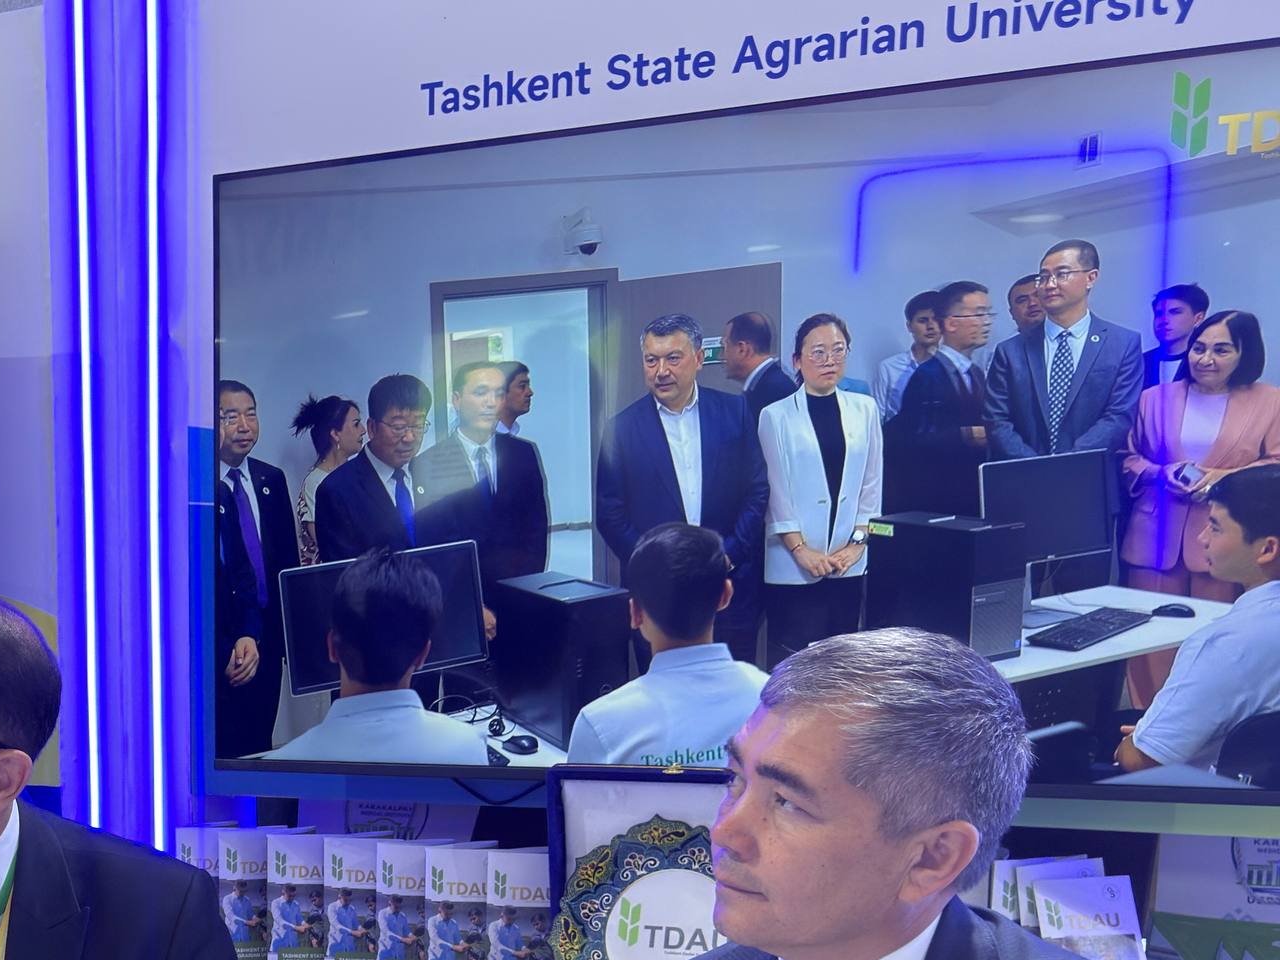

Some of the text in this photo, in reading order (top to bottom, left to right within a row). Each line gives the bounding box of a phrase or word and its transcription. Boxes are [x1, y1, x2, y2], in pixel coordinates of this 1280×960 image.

[421, 62, 592, 116] Tashkent
[607, 46, 716, 91] State
[732, 17, 925, 80] Agrarian
[1218, 110, 1280, 156] TD
